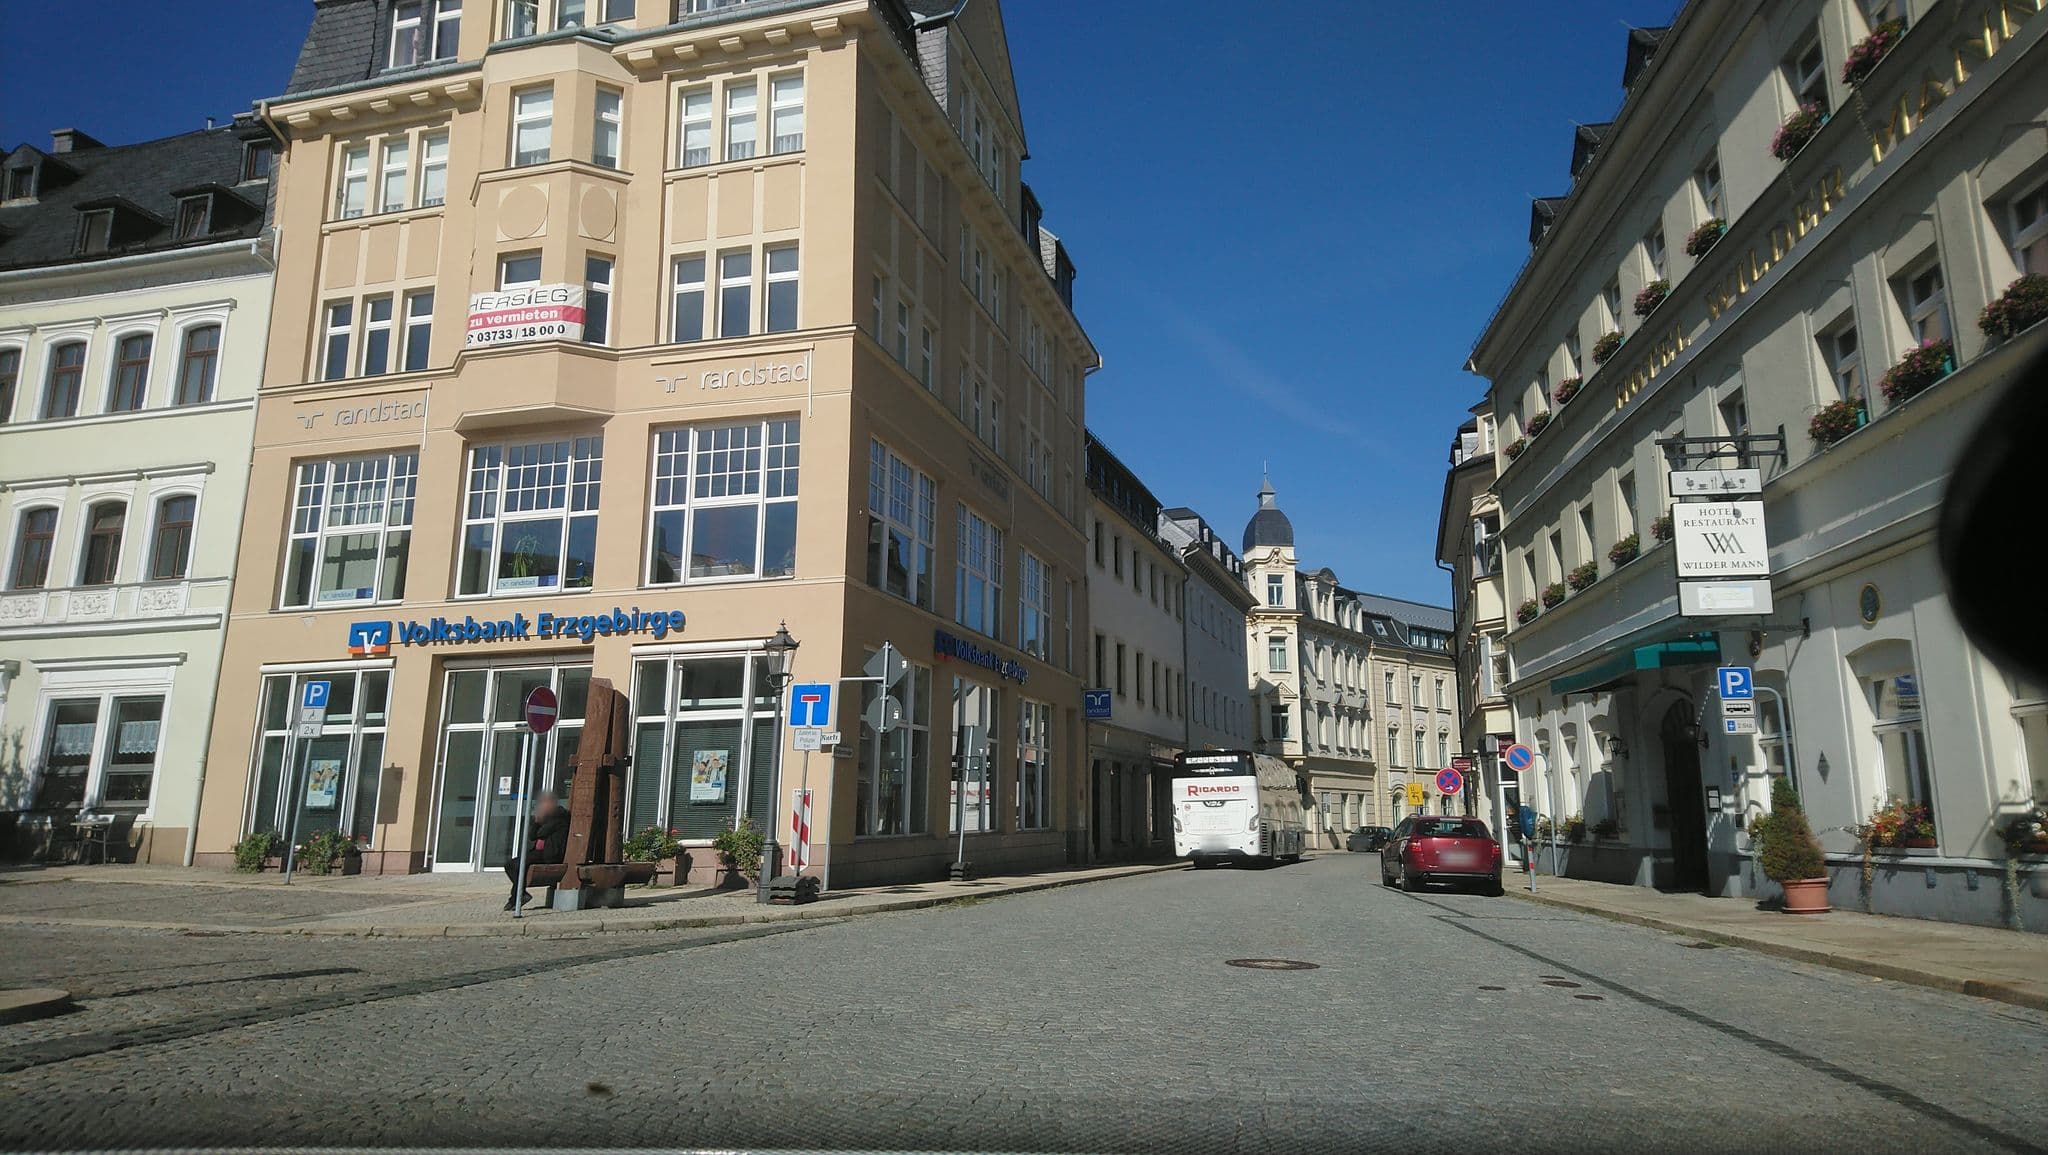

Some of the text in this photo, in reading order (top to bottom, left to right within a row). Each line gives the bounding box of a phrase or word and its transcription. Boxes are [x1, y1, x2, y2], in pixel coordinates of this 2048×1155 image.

[469, 309, 558, 328] zu vermieten
[477, 328, 513, 343] 03733
[521, 326, 536, 338] 18
[700, 351, 810, 390] randstad
[334, 391, 427, 426] randstad
[1699, 508, 1742, 517] HOTEL
[1683, 517, 1757, 528] RESTAURANT
[1683, 560, 1765, 570] WILDER MANN
[397, 607, 686, 646] Volksbank Erzgebirge
[955, 638, 994, 672] Volksbank
[1725, 671, 1745, 695] P
[309, 684, 325, 705] P
[303, 725, 316, 735] 2x
[1187, 785, 1240, 796] RICARDO
